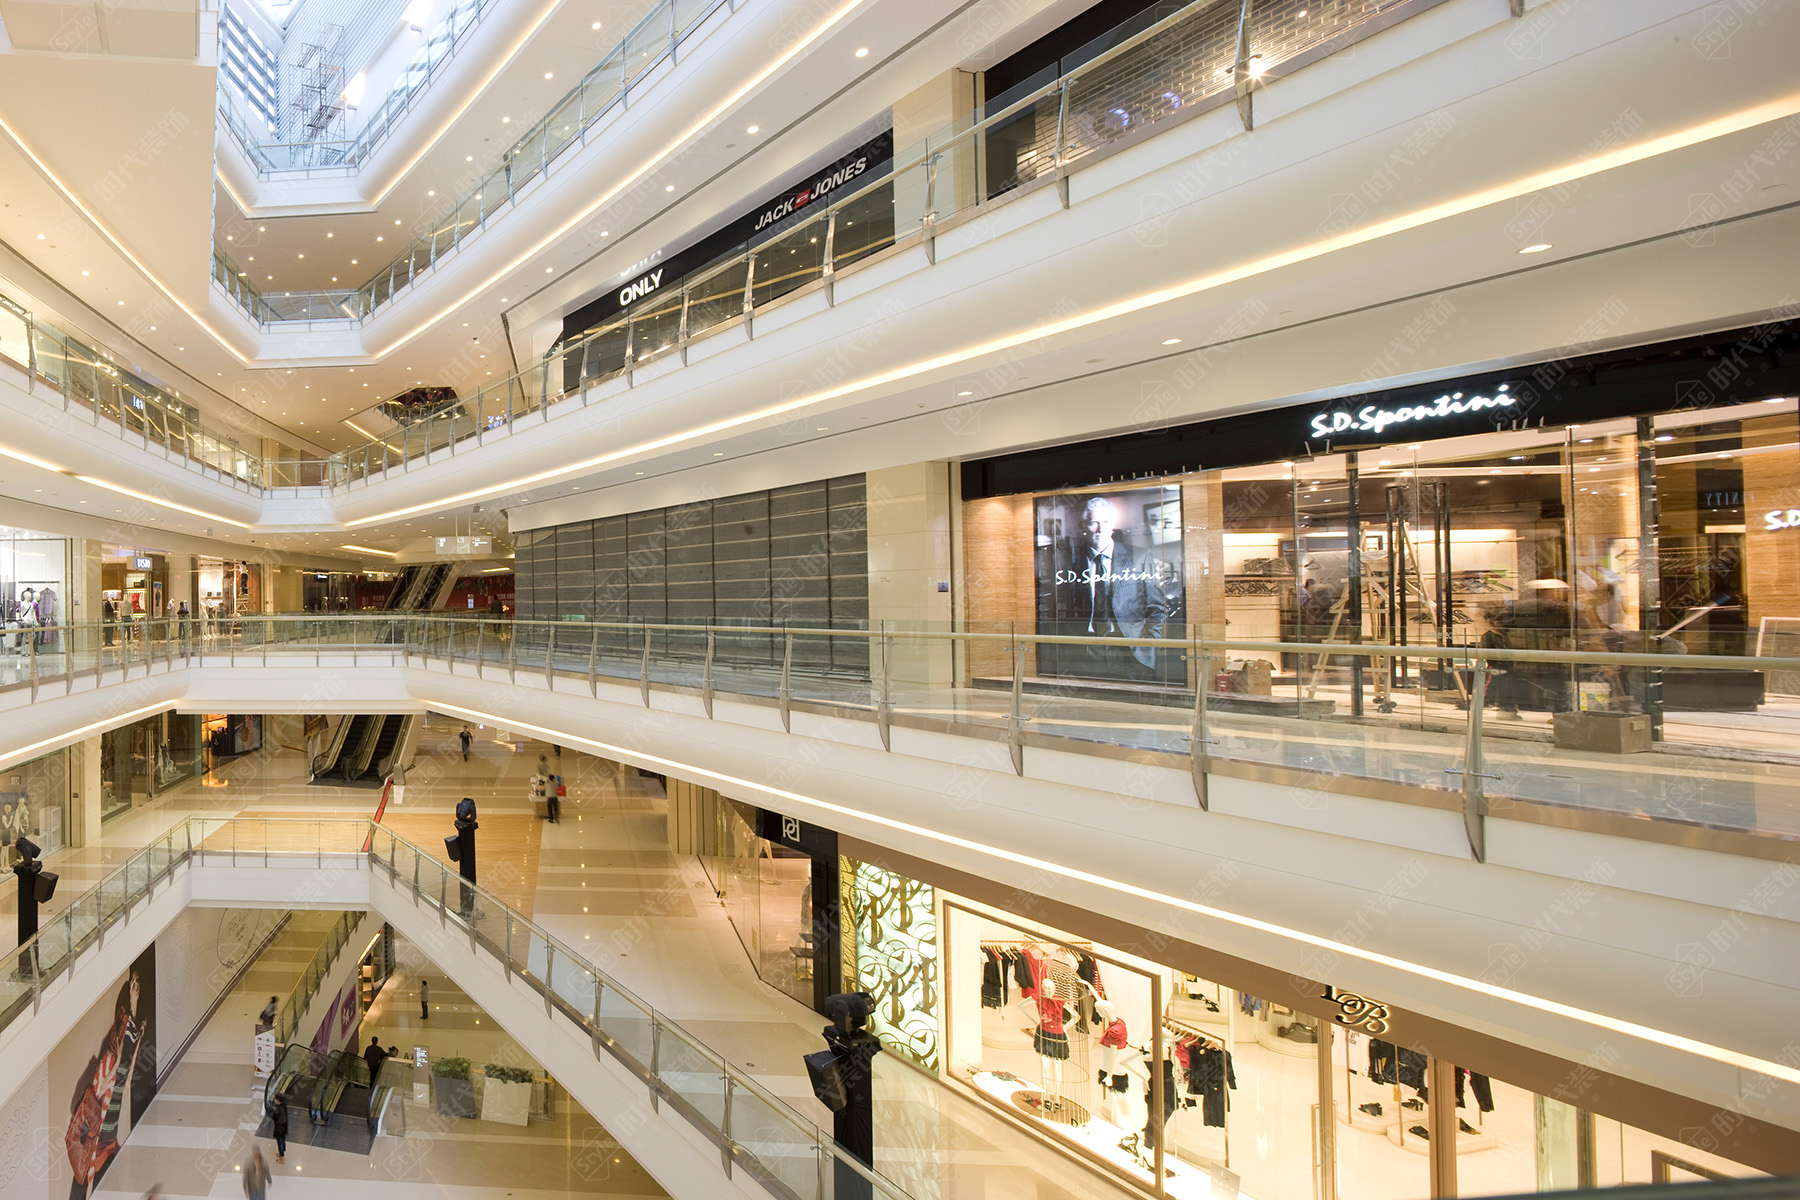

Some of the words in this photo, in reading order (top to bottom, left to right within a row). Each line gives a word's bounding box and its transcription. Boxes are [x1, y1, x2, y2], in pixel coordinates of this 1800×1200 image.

[755, 196, 796, 231] JACK
[810, 157, 868, 200] JONES
[619, 268, 663, 306] ONLY
